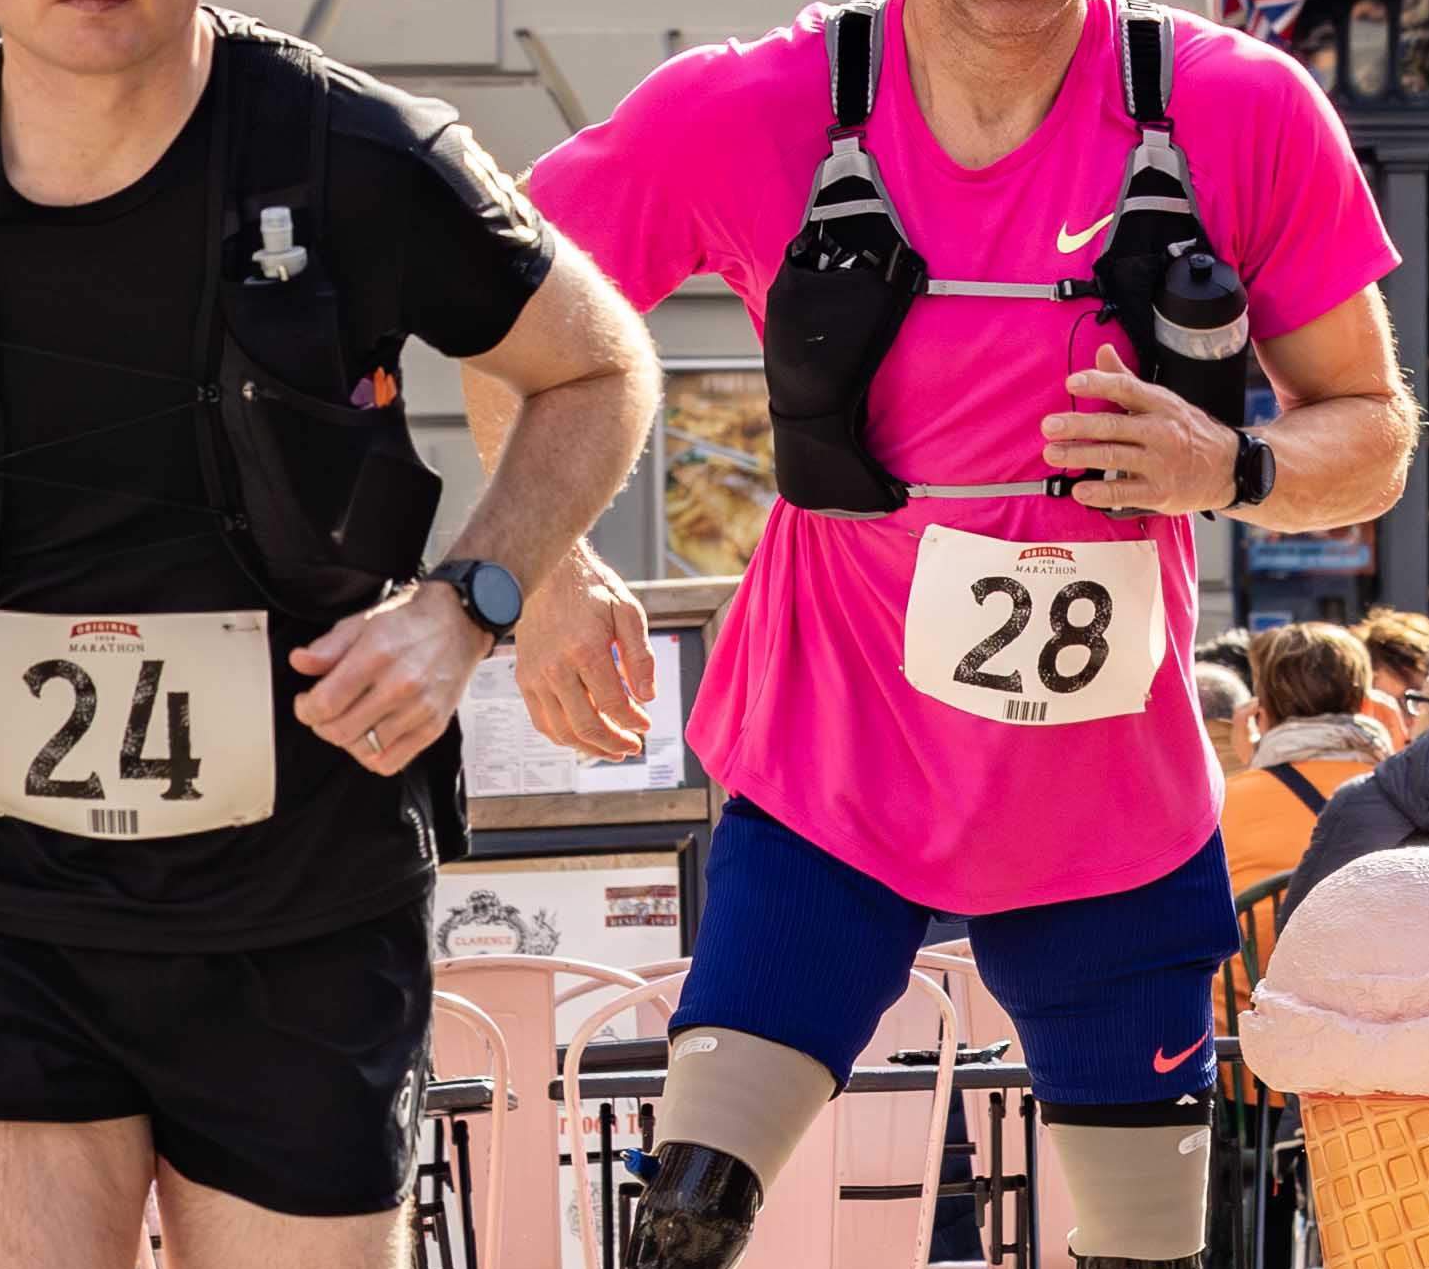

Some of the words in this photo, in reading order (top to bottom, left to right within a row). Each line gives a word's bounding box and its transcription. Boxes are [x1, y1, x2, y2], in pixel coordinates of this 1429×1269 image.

[1024, 547, 1069, 558] ORIGINAL
[1014, 565, 1077, 574] MARATHON
[76, 622, 133, 634] ORIGINAL
[952, 576, 1113, 694] 28
[69, 644, 145, 653] MARATHON
[22, 659, 203, 801] 24
[454, 934, 513, 947] CLARENCE
